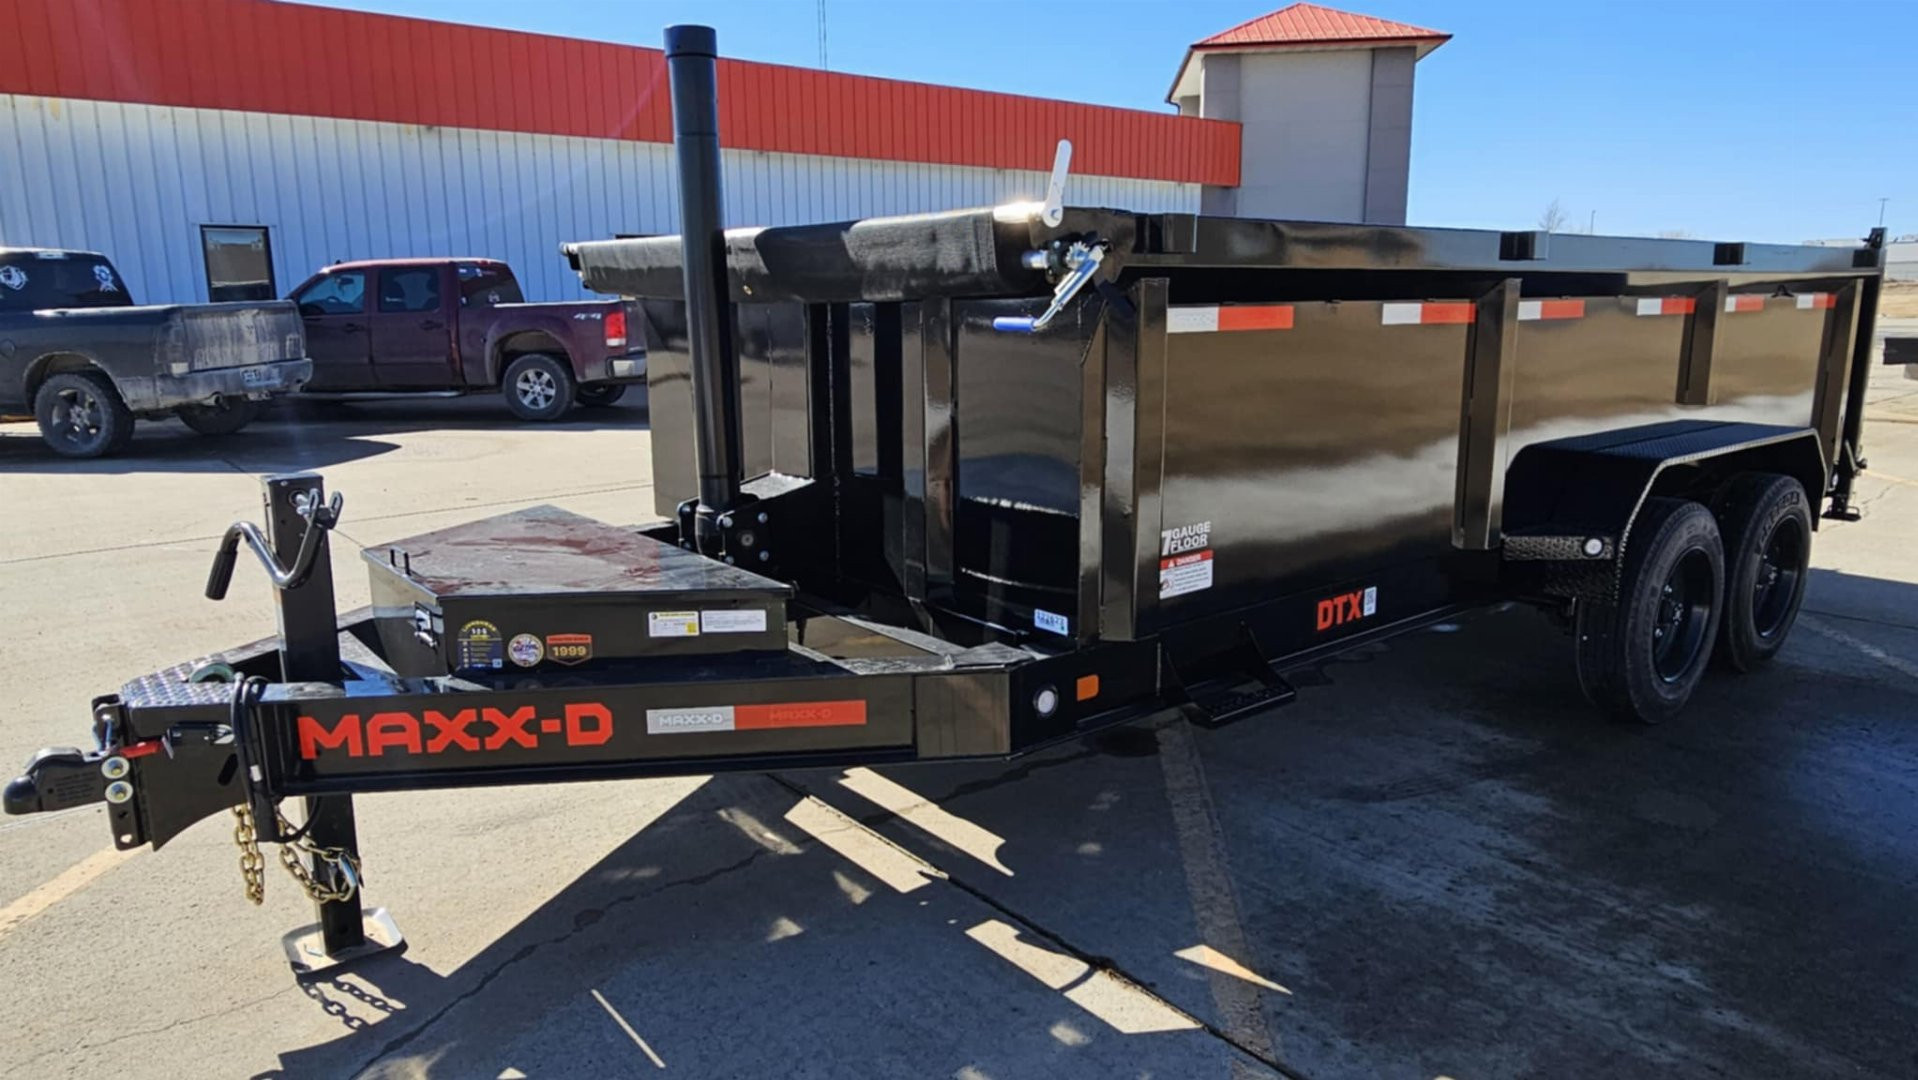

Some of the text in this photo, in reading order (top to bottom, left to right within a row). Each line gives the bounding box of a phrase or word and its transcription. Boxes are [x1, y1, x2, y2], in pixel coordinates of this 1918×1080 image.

[1161, 521, 1211, 556] 7 GAUGE
[1170, 534, 1208, 554] FLOOR
[1317, 590, 1362, 631] DTX
[552, 645, 587, 656] 1999
[297, 703, 613, 760] MAXX-D
[659, 713, 723, 727] MAXX-D
